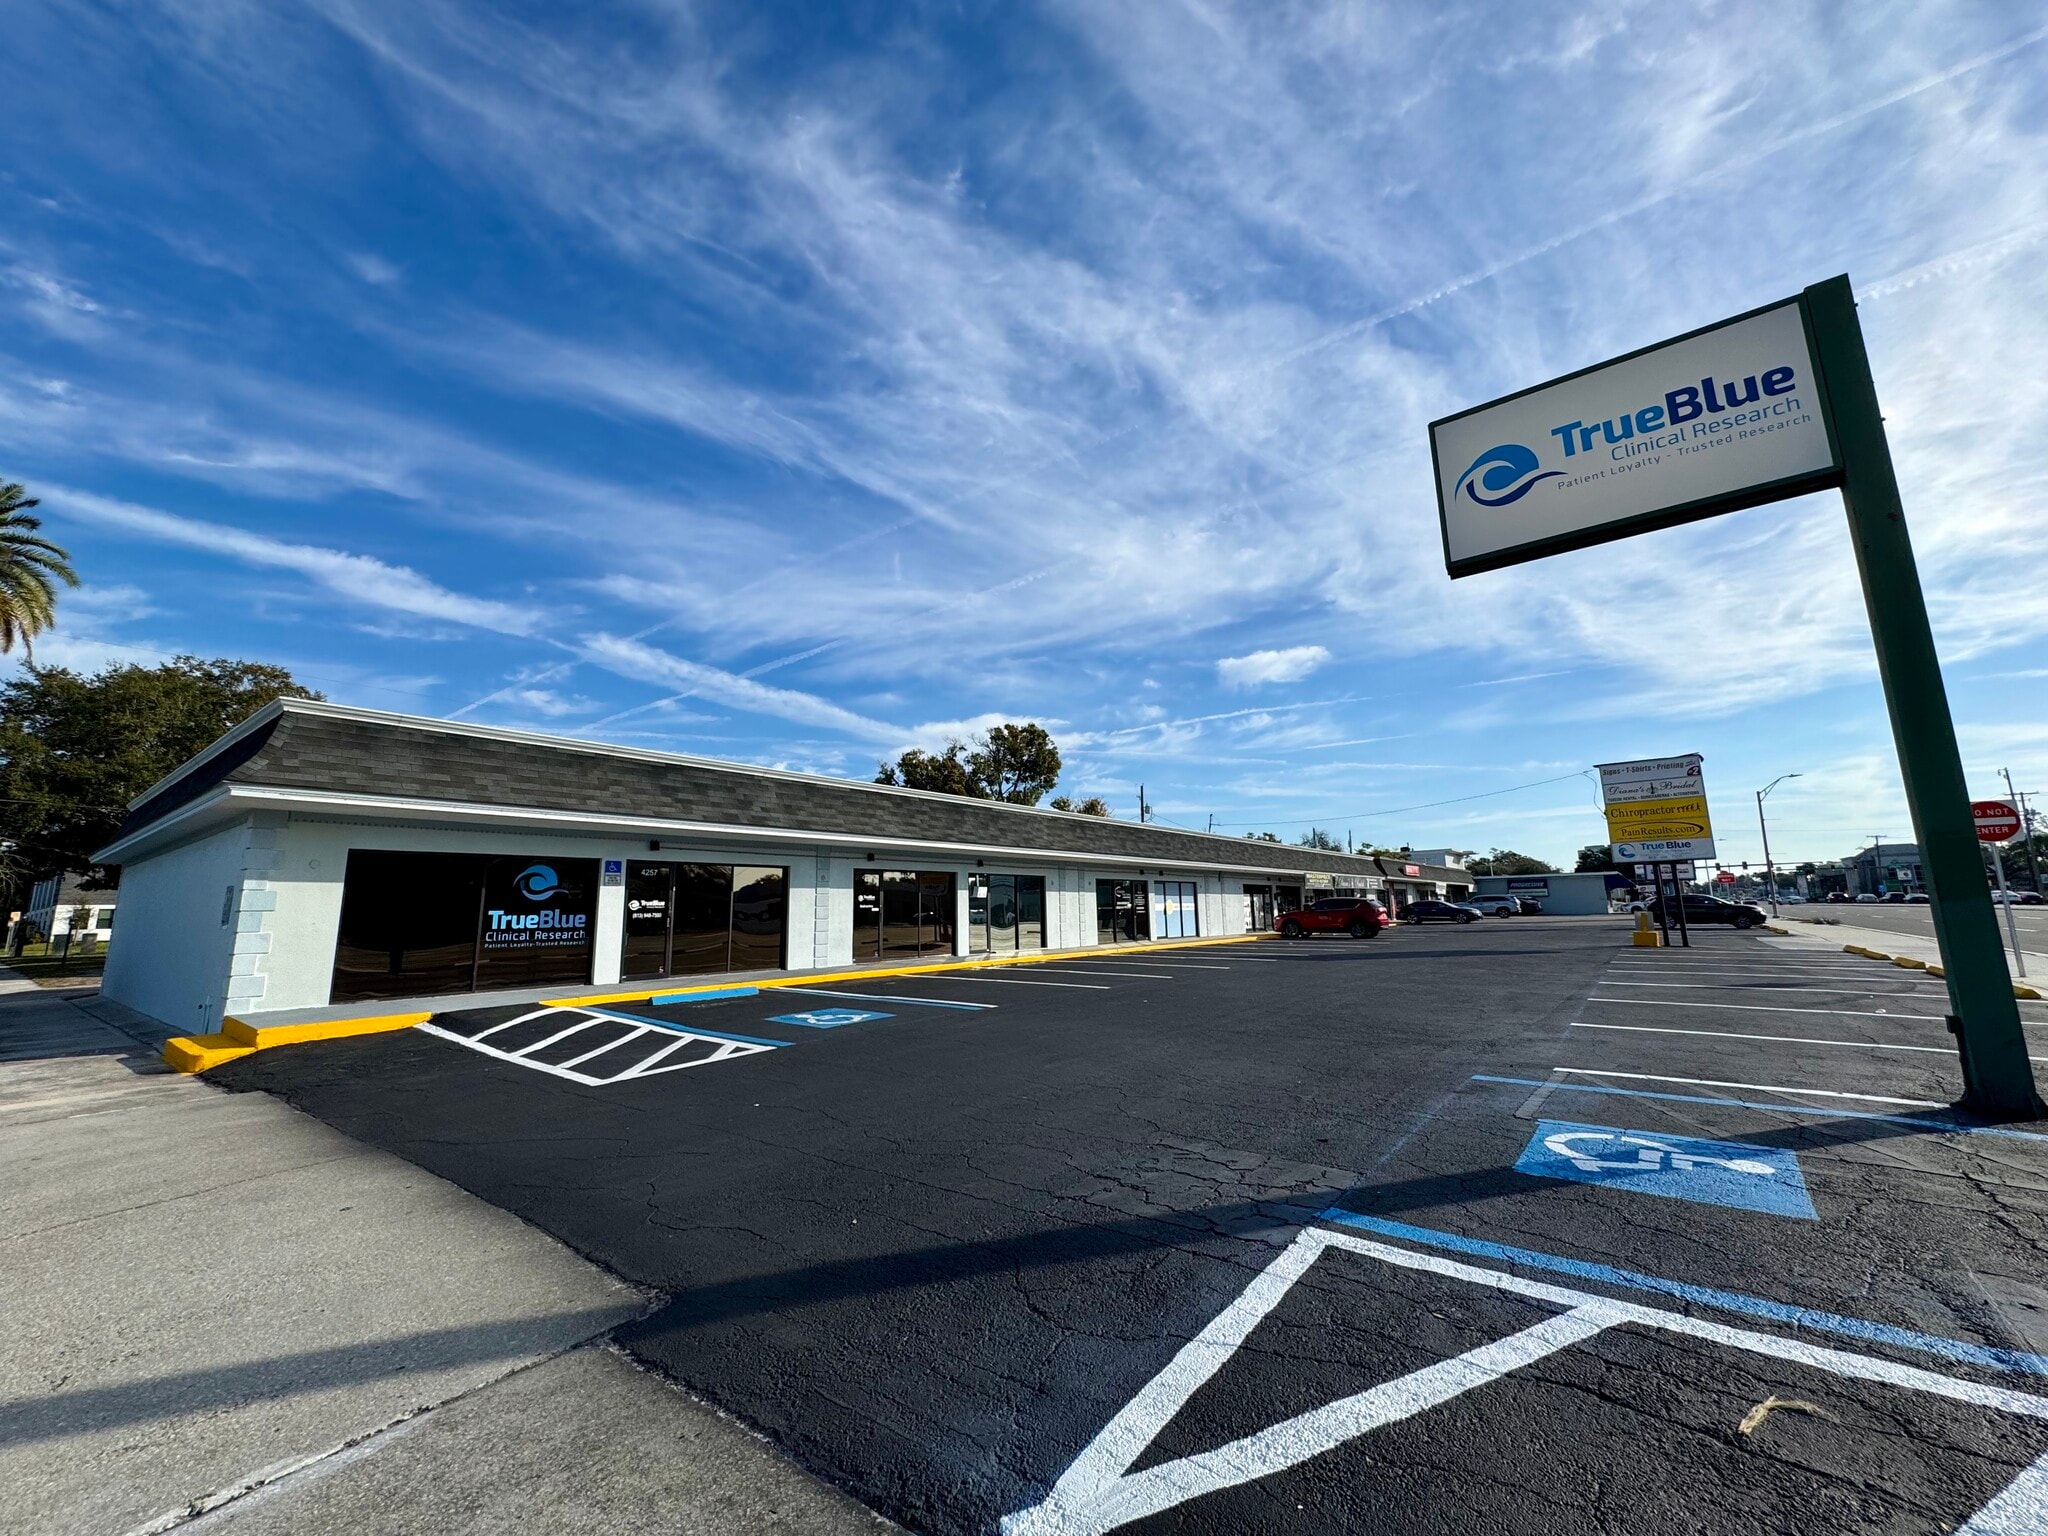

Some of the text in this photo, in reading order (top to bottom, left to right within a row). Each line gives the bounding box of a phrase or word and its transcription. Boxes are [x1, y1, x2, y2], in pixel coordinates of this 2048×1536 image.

[1551, 366, 1796, 457] TrueBlue
[1611, 397, 1801, 461] Clinical Research
[1557, 470, 1606, 490] Patient
[1610, 455, 1661, 475] Loyalty
[1676, 434, 1733, 456] Trusted
[1738, 413, 1811, 440] Research
[1603, 768, 1621, 776] Signs
[1626, 765, 1652, 773] T-Shirts
[1657, 762, 1684, 771] Printing
[1659, 780, 1697, 791] Bridal
[1610, 806, 1677, 818] Chiropractor
[1986, 808, 2009, 816] NOT
[1621, 826, 1696, 837] PainResults.com
[1976, 826, 2009, 835] ENTER
[1640, 842, 1665, 851] True
[1666, 841, 1692, 849] Blue
[641, 868, 658, 876] 4257
[488, 909, 586, 930] TrueBlue
[485, 930, 586, 942] Clinical Research
